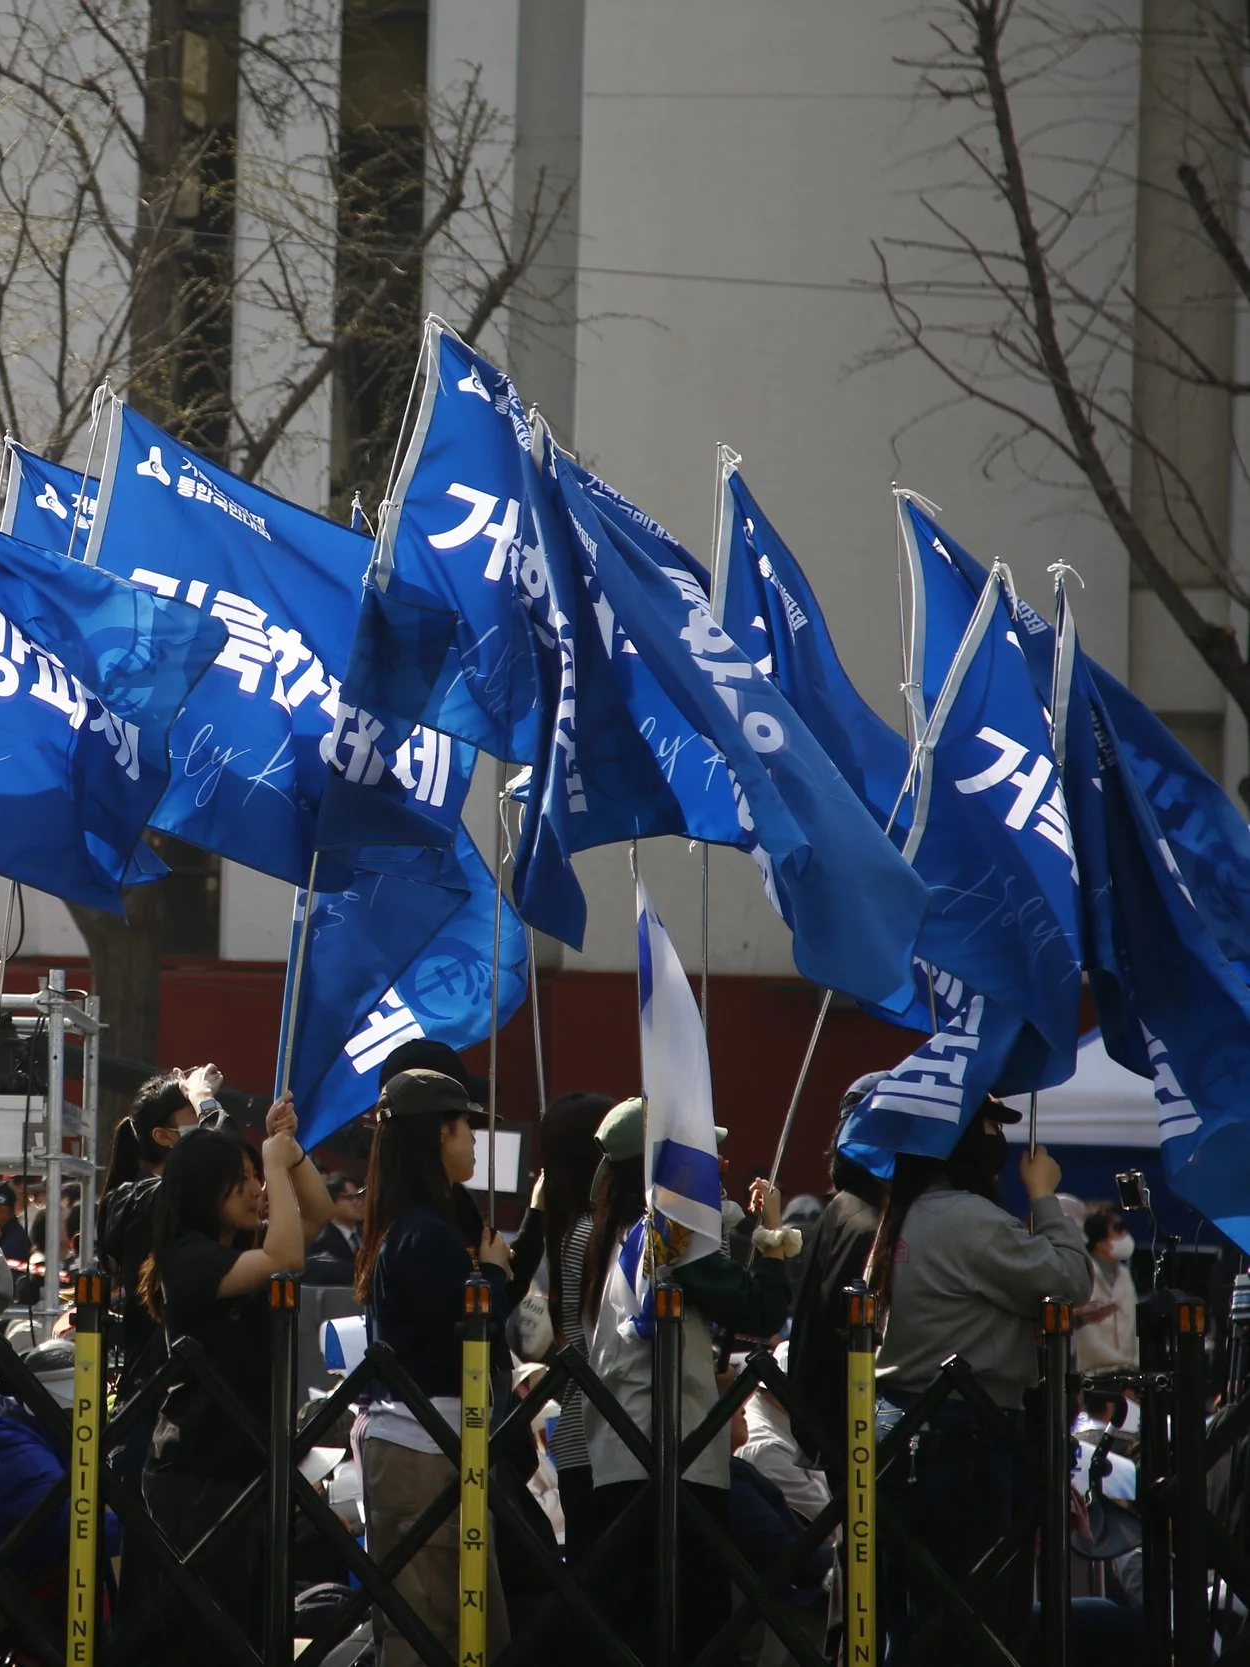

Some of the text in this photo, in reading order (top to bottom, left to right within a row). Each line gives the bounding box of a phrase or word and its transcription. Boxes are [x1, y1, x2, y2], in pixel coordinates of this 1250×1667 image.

[72, 1397, 94, 1663] POLICE LINE
[852, 1419, 871, 1564] POLICE
